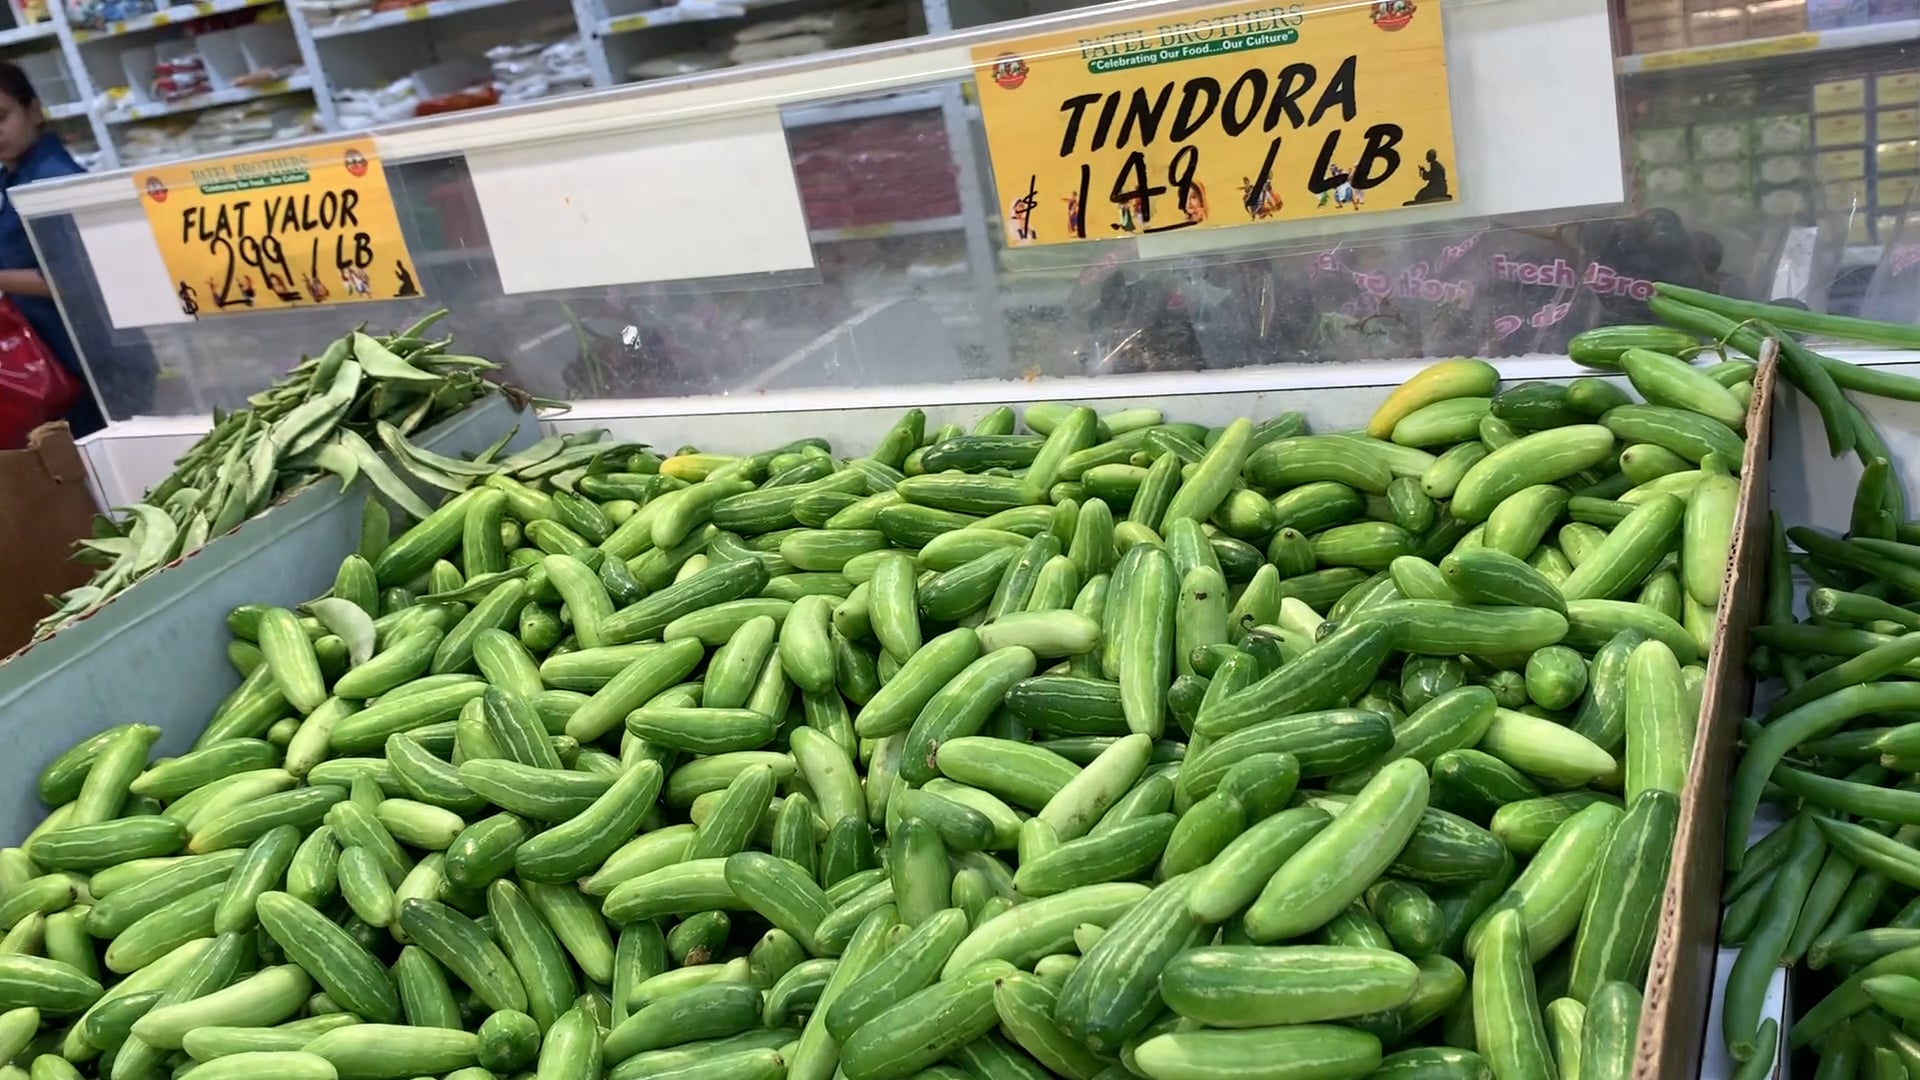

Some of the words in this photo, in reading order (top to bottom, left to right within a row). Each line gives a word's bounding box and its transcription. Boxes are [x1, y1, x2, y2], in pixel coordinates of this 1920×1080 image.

[1078, 30, 1153, 59] PATEL
[1158, 4, 1304, 48] BROTHERS
[1159, 49, 1181, 60] Our
[1059, 55, 1358, 157] TINDORA
[1308, 123, 1405, 194] LB
[182, 200, 251, 244] FLAT
[264, 188, 359, 236] VALOR
[336, 232, 374, 270] LB
